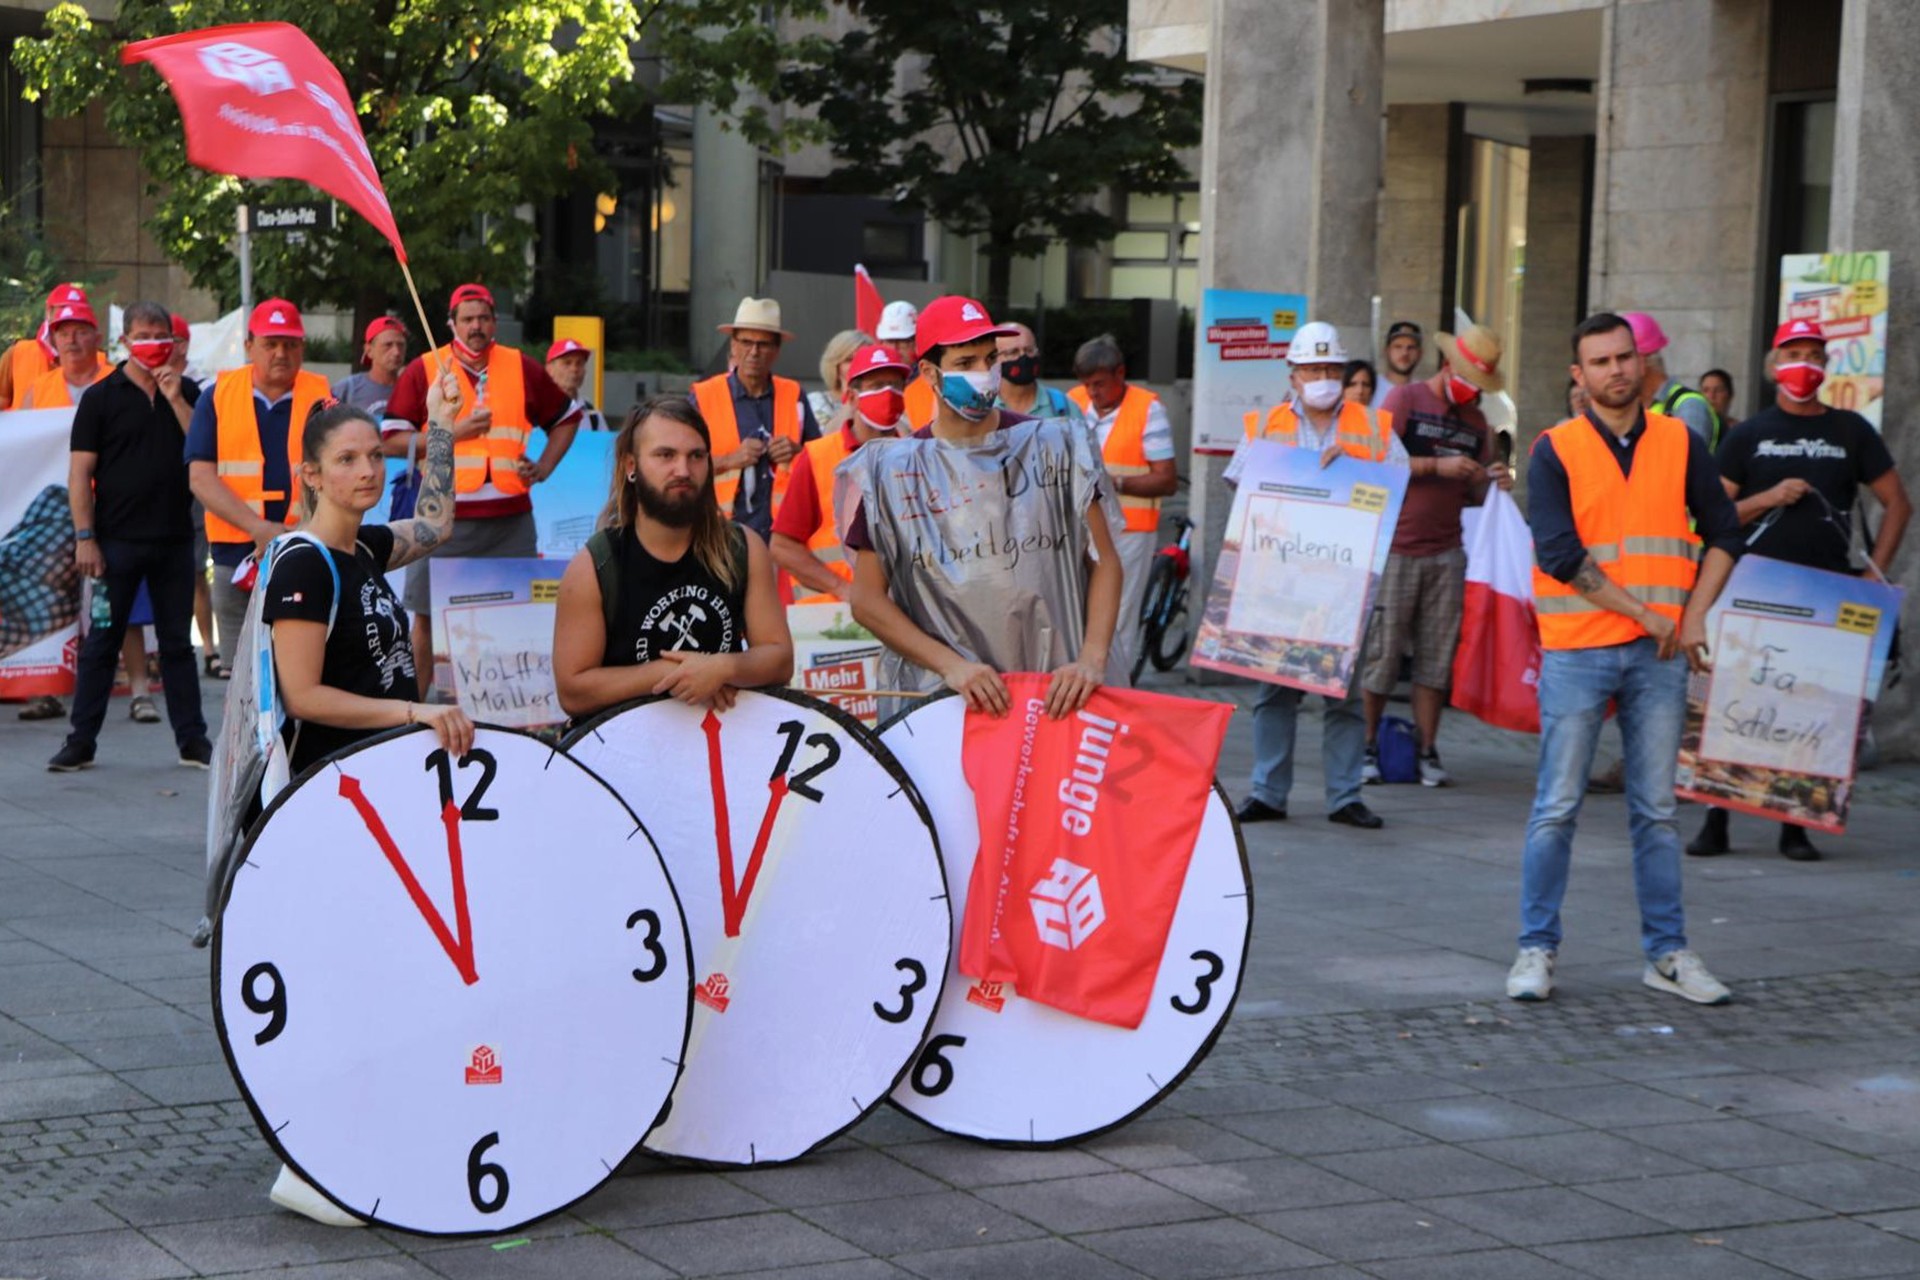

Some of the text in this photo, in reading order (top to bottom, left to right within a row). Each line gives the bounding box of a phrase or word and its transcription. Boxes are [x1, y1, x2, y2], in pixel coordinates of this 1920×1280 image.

[1251, 517, 1354, 563] Implenia
[641, 585, 708, 630] WORKING
[710, 595, 733, 653] HEROE
[810, 668, 860, 689] Mehr
[425, 747, 499, 822] 12
[770, 719, 841, 803] 12
[1059, 710, 1129, 837] junge
[626, 908, 668, 983] 3
[240, 962, 288, 1046] 9
[873, 958, 926, 1024] 3
[1170, 950, 1224, 1015] 3
[911, 1033, 967, 1097] 6
[467, 1131, 510, 1214] 6
